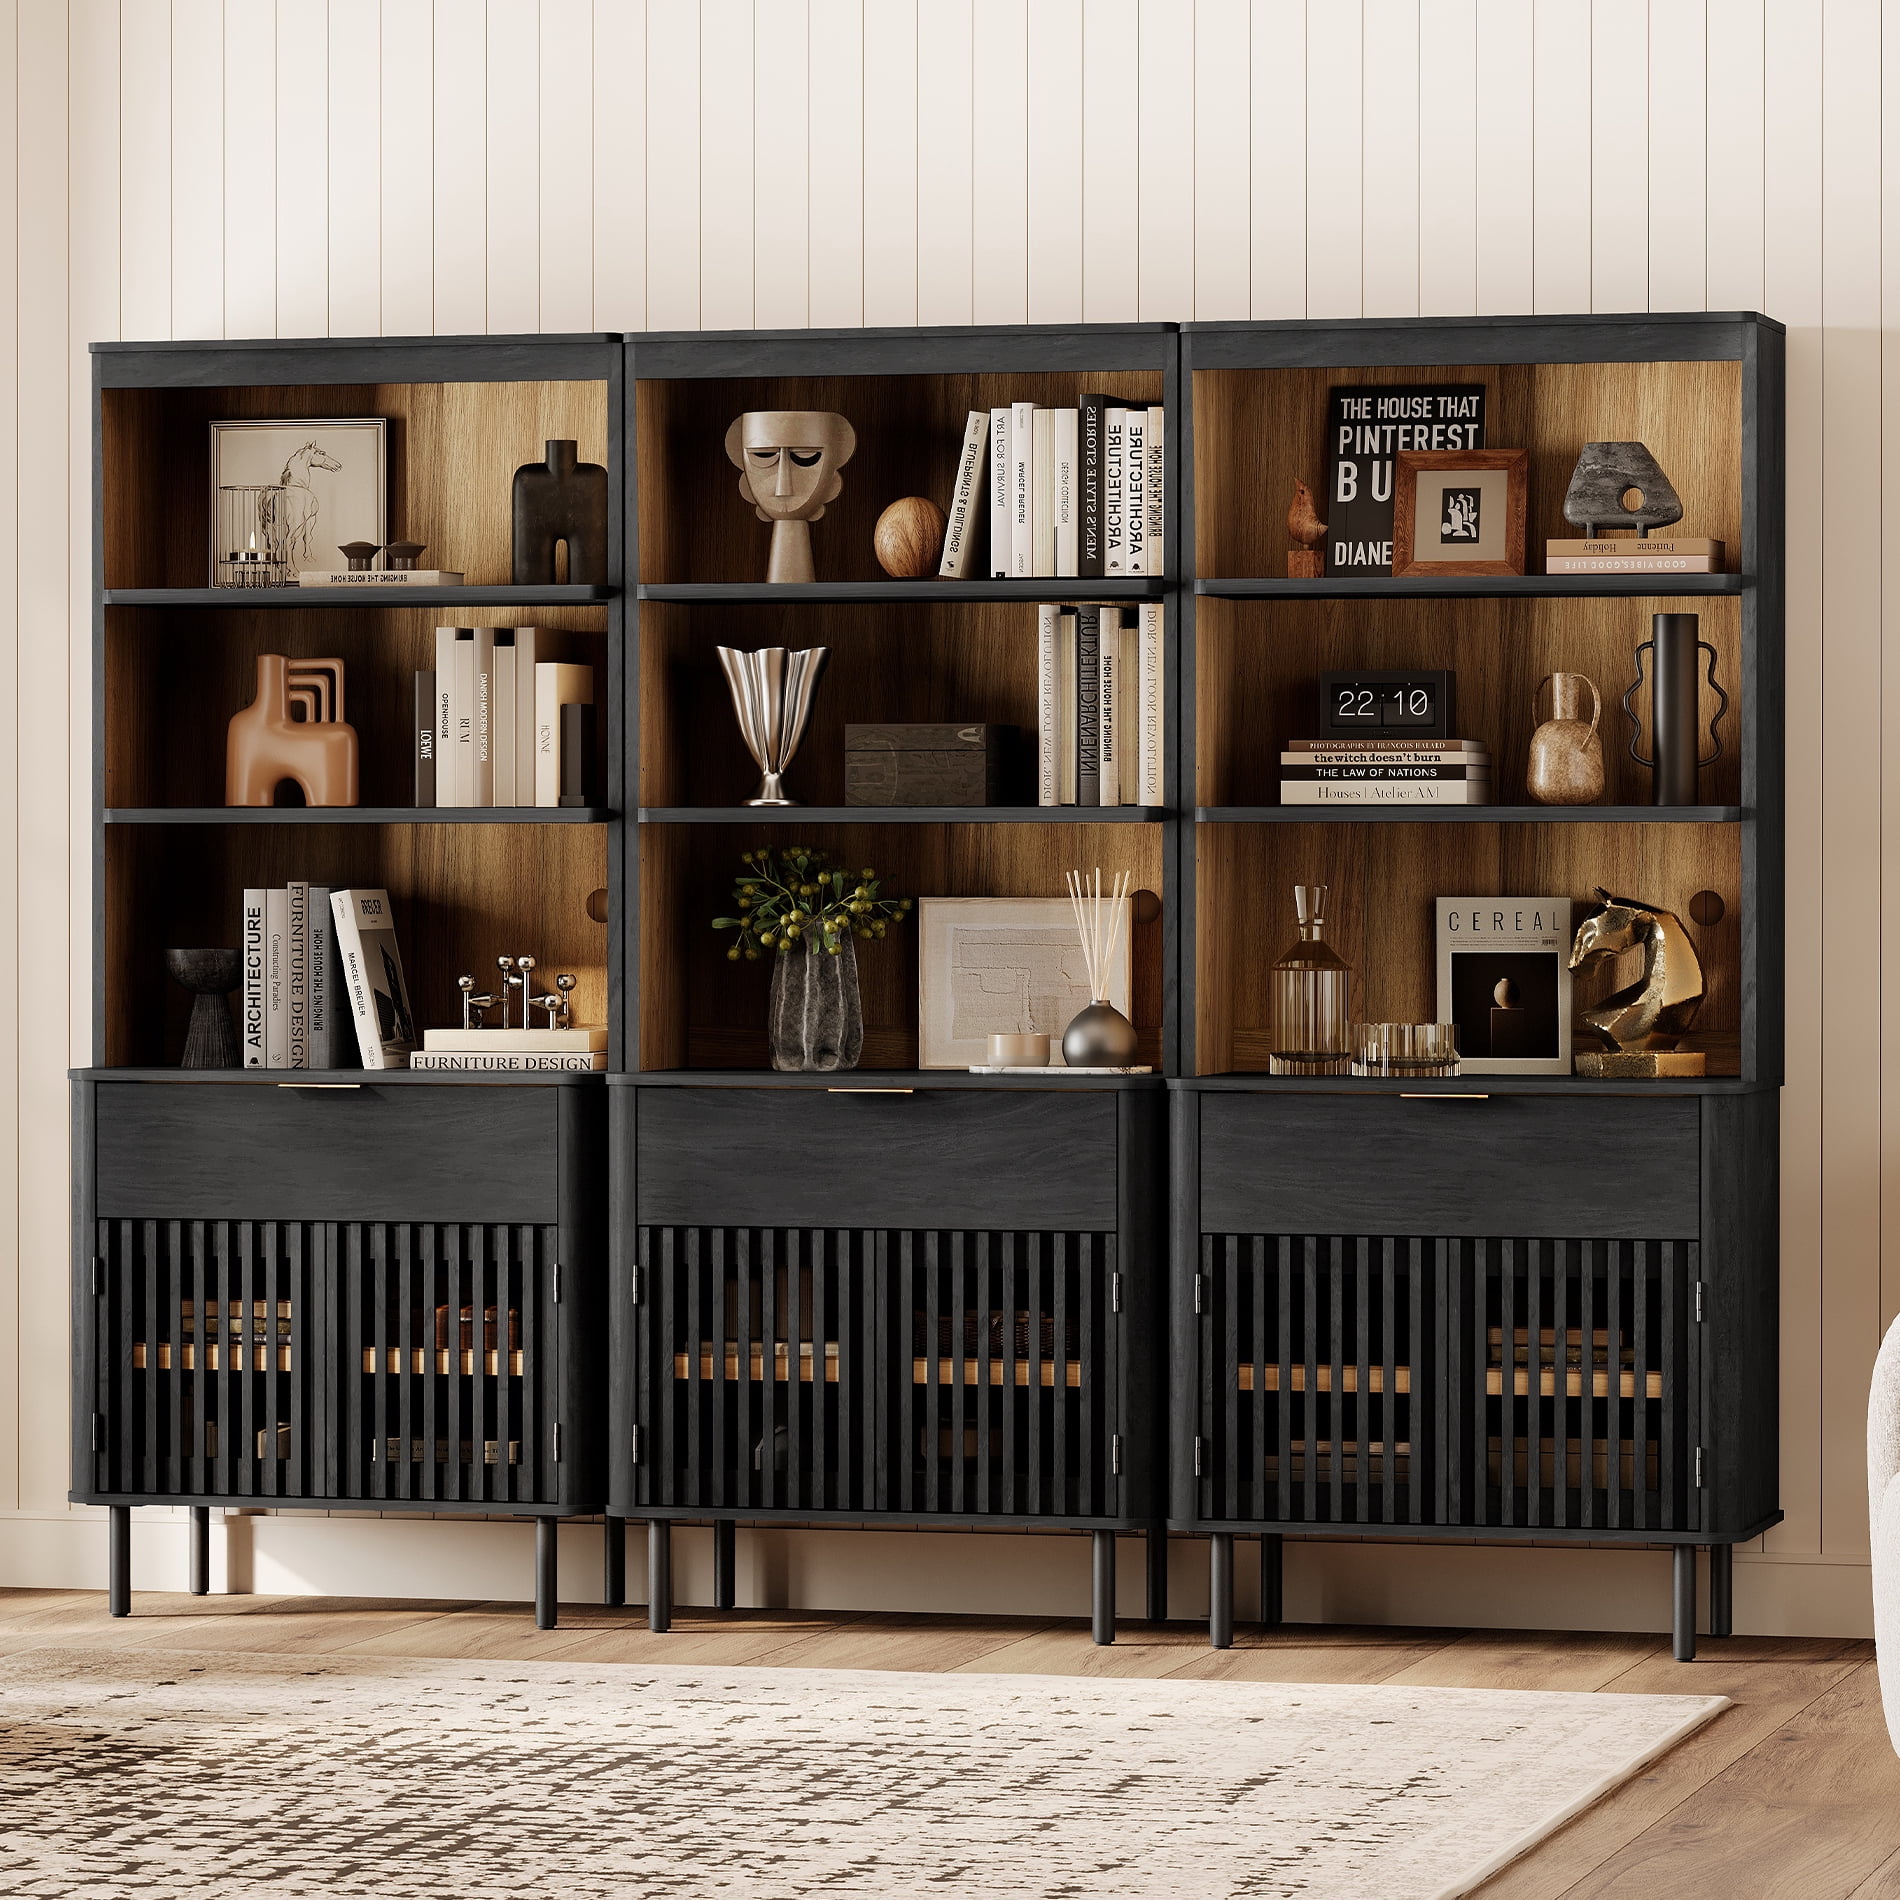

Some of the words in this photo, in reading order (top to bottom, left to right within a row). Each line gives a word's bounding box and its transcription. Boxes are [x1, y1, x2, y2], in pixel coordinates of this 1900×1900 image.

[1340, 398, 1372, 420] THE
[1377, 396, 1432, 419] HOUSE
[1436, 396, 1479, 418] THAT
[1338, 424, 1479, 455] PINTEREST
[1334, 541, 1393, 567] DIANE
[1583, 541, 1616, 553] Holiday
[480, 673, 488, 700] DANISH
[1338, 690, 1375, 716] 22
[1393, 690, 1428, 716] 10
[460, 718, 470, 743] RUM
[480, 702, 488, 734] MODERN
[420, 730, 432, 759] LOEWE
[480, 734, 488, 762] DESIGN
[541, 724, 550, 754] HONNE
[1314, 753, 1335, 763] the
[1335, 753, 1368, 763] witch
[1369, 753, 1411, 763] doesn't
[1413, 753, 1442, 763] burn
[1316, 768, 1339, 777] THE
[1342, 768, 1366, 777] LAW
[1369, 768, 1383, 777] OF
[1388, 768, 1438, 777] NATIONS
[1318, 786, 1361, 799] Houses
[1370, 786, 1413, 799] Atelier
[1415, 786, 1439, 799] AM
[1448, 911, 1560, 931] CEREAL
[292, 886, 304, 995] FURNITURE
[270, 934, 281, 979] Constructing
[248, 907, 262, 1048] ARCHITECTURE
[347, 951, 361, 984] MARCEL
[354, 985, 366, 1016] BREUER
[272, 981, 281, 1011] Paradies
[292, 1001, 304, 1069] DESIGN
[413, 1057, 519, 1069] FURNITURE
[525, 1057, 592, 1070] DESIGN
